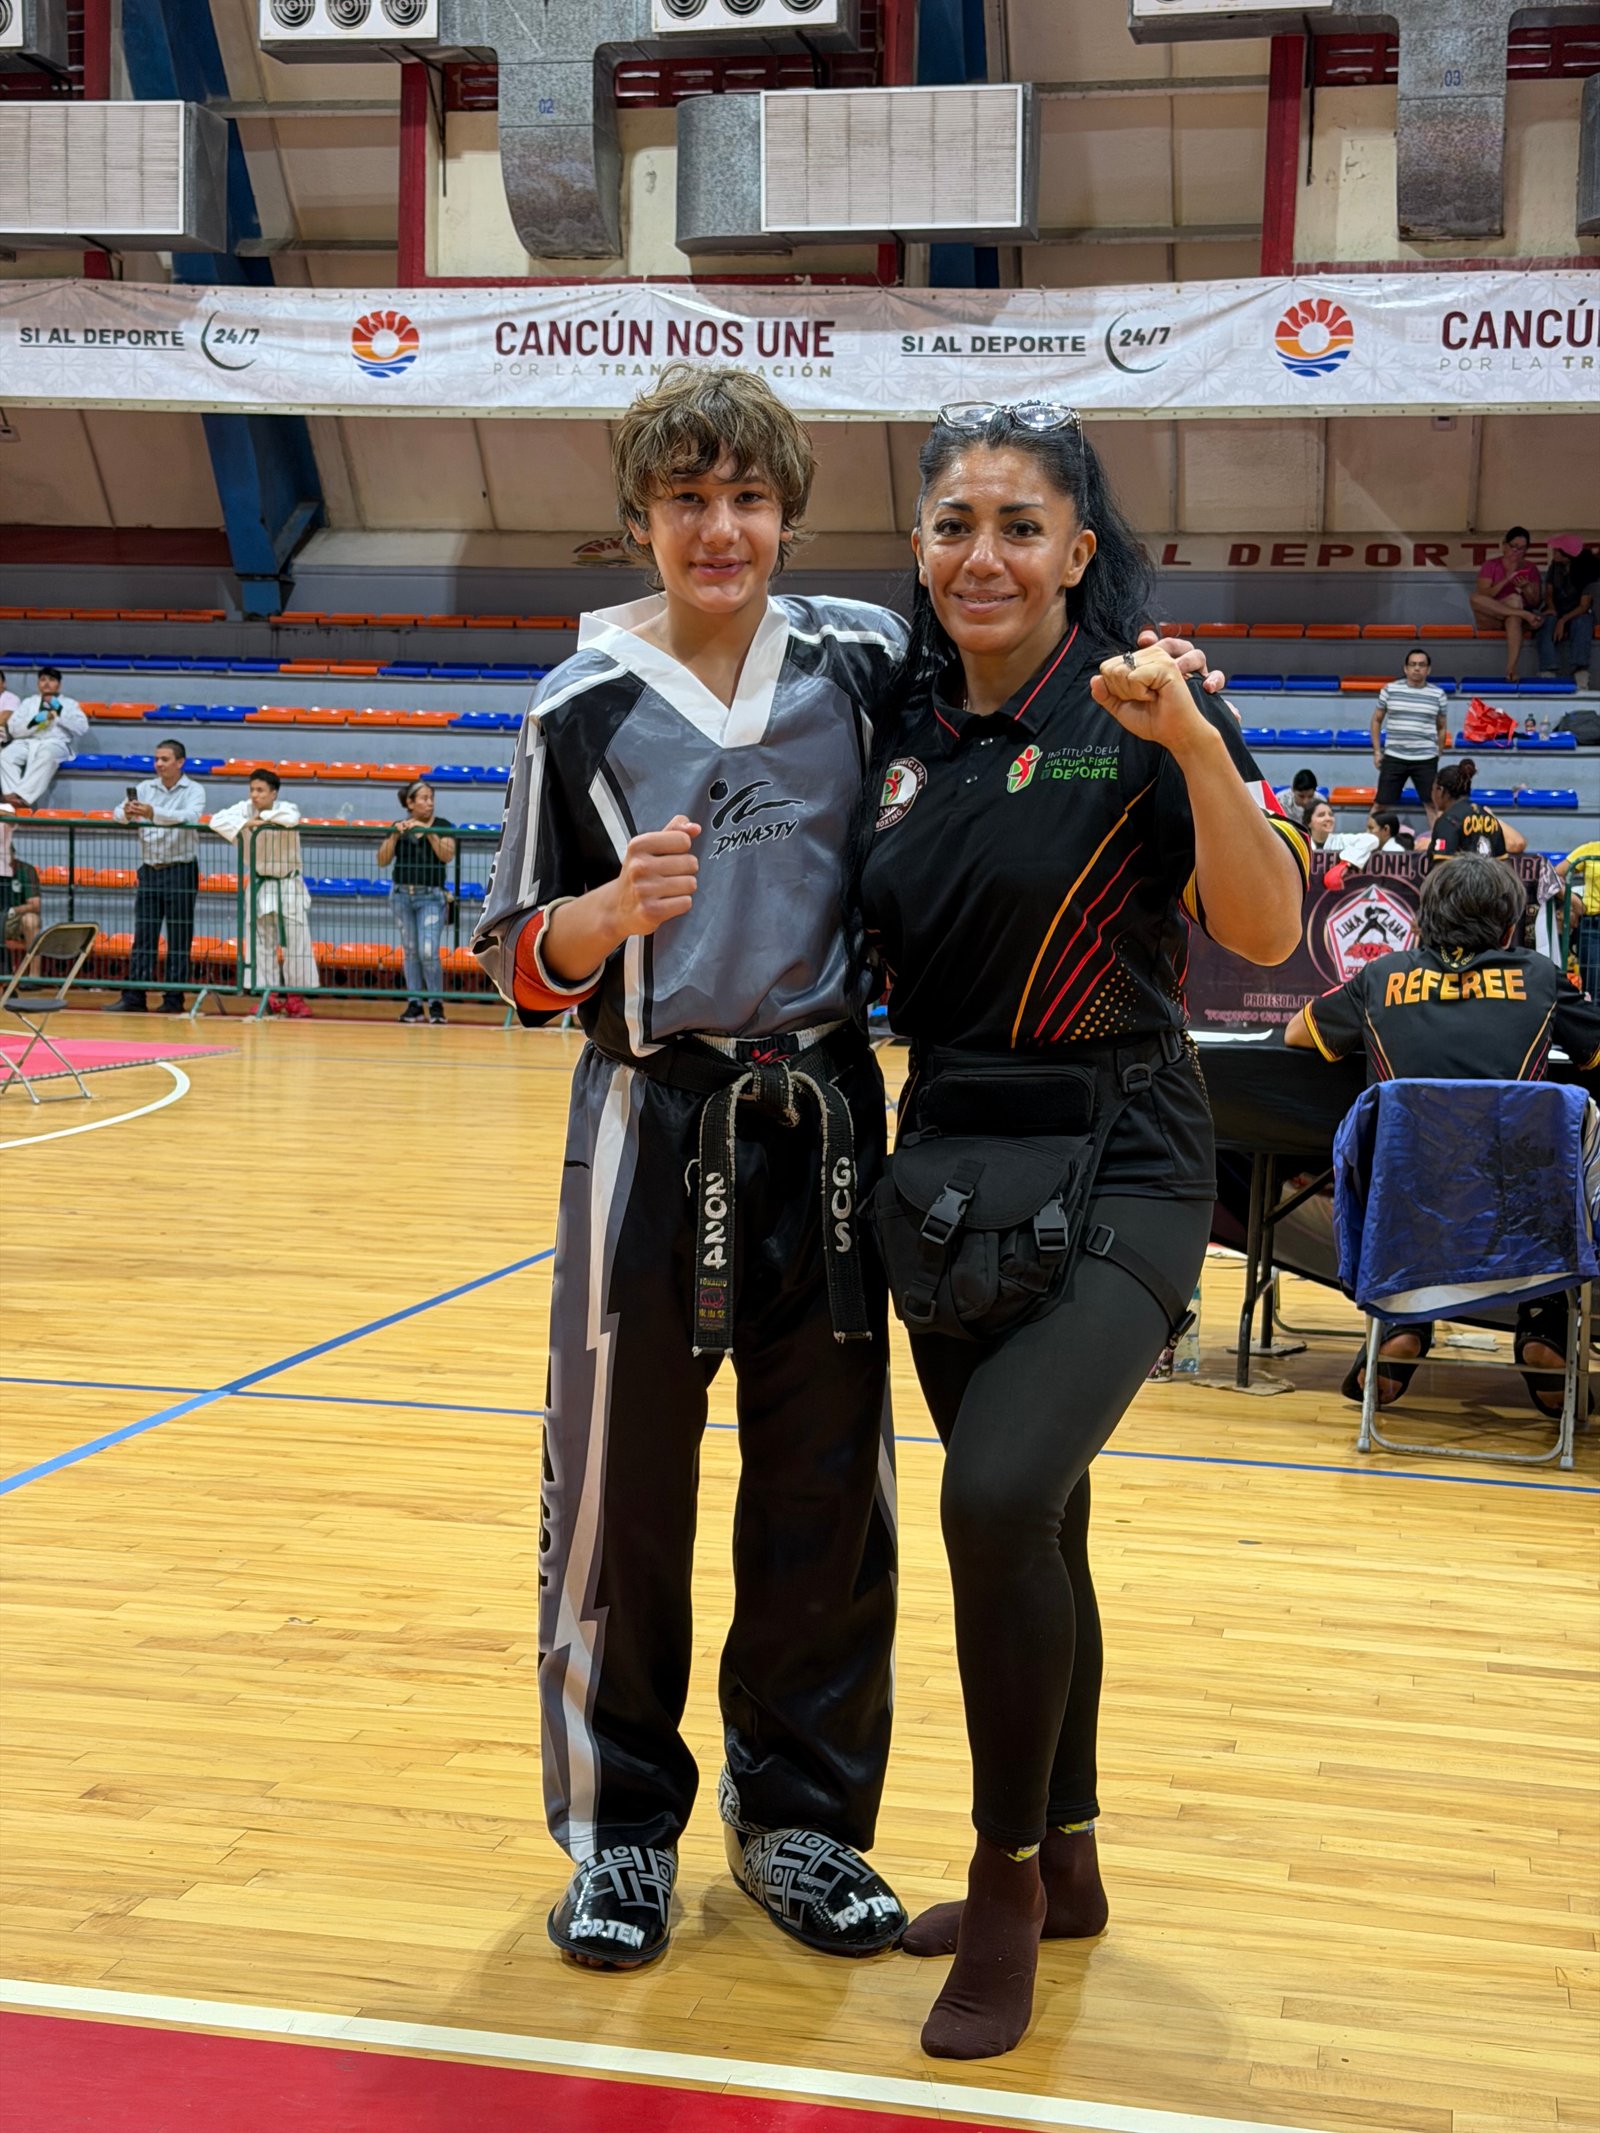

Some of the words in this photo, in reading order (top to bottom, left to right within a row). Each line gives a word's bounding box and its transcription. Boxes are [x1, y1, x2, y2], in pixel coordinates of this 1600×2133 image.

[1444, 69, 1462, 87] 03
[538, 98, 554, 114] 02
[495, 310, 653, 357] CANCÚN
[667, 319, 744, 357] NOS
[757, 320, 836, 358] UNE
[1442, 299, 1600, 351] CANCÚ
[20, 327, 40, 344] SI
[48, 328, 76, 344] AL
[83, 328, 185, 347] DEPORTE
[213, 328, 260, 345] 24/7
[901, 335, 924, 352] SI
[932, 336, 962, 352] AL
[971, 335, 1086, 353] DEPORTE
[1119, 327, 1171, 347] 24/7
[493, 362, 540, 377] POR
[556, 362, 583, 376] LA
[1439, 357, 1493, 372] POR
[1512, 357, 1543, 371] LA
[1562, 356, 1600, 370] TR
[709, 819, 799, 860] DYNASTY
[1336, 914, 1364, 938] LIMA
[1381, 918, 1408, 941] LAMA
[1385, 967, 1527, 1007] REFEREE
[831, 1157, 851, 1253] GUS
[702, 1172, 728, 1270] 2024
